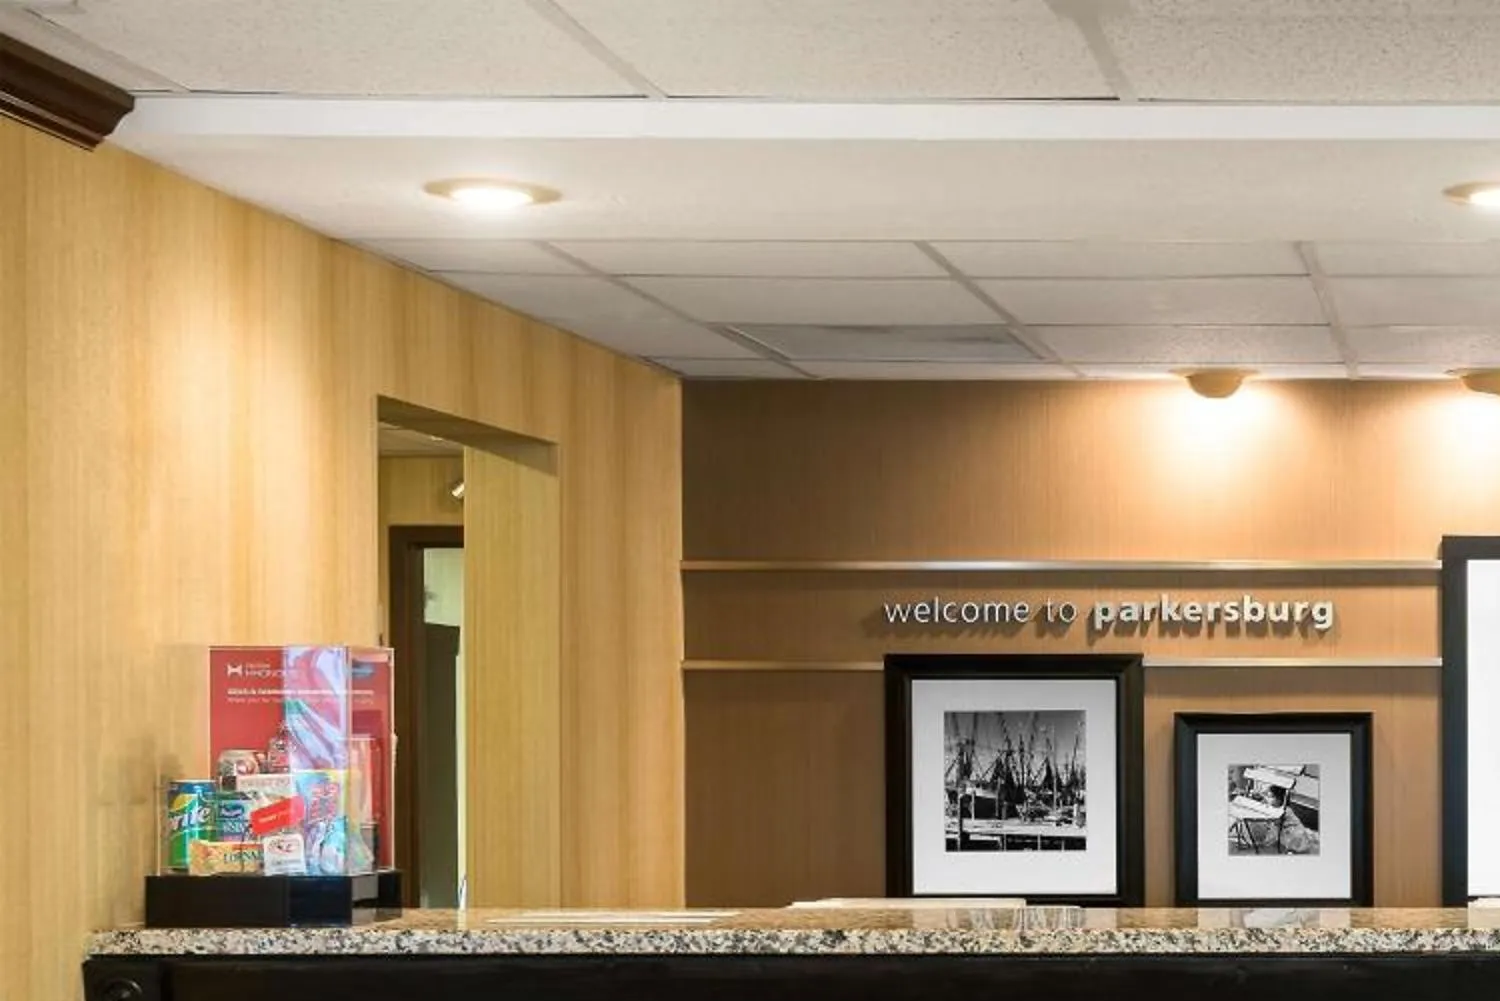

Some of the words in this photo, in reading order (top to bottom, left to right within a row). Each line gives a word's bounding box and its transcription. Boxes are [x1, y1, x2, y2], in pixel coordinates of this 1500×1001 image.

[883, 596, 1030, 623] welcome
[1047, 598, 1078, 623] to
[1094, 593, 1334, 630] parkersburg
